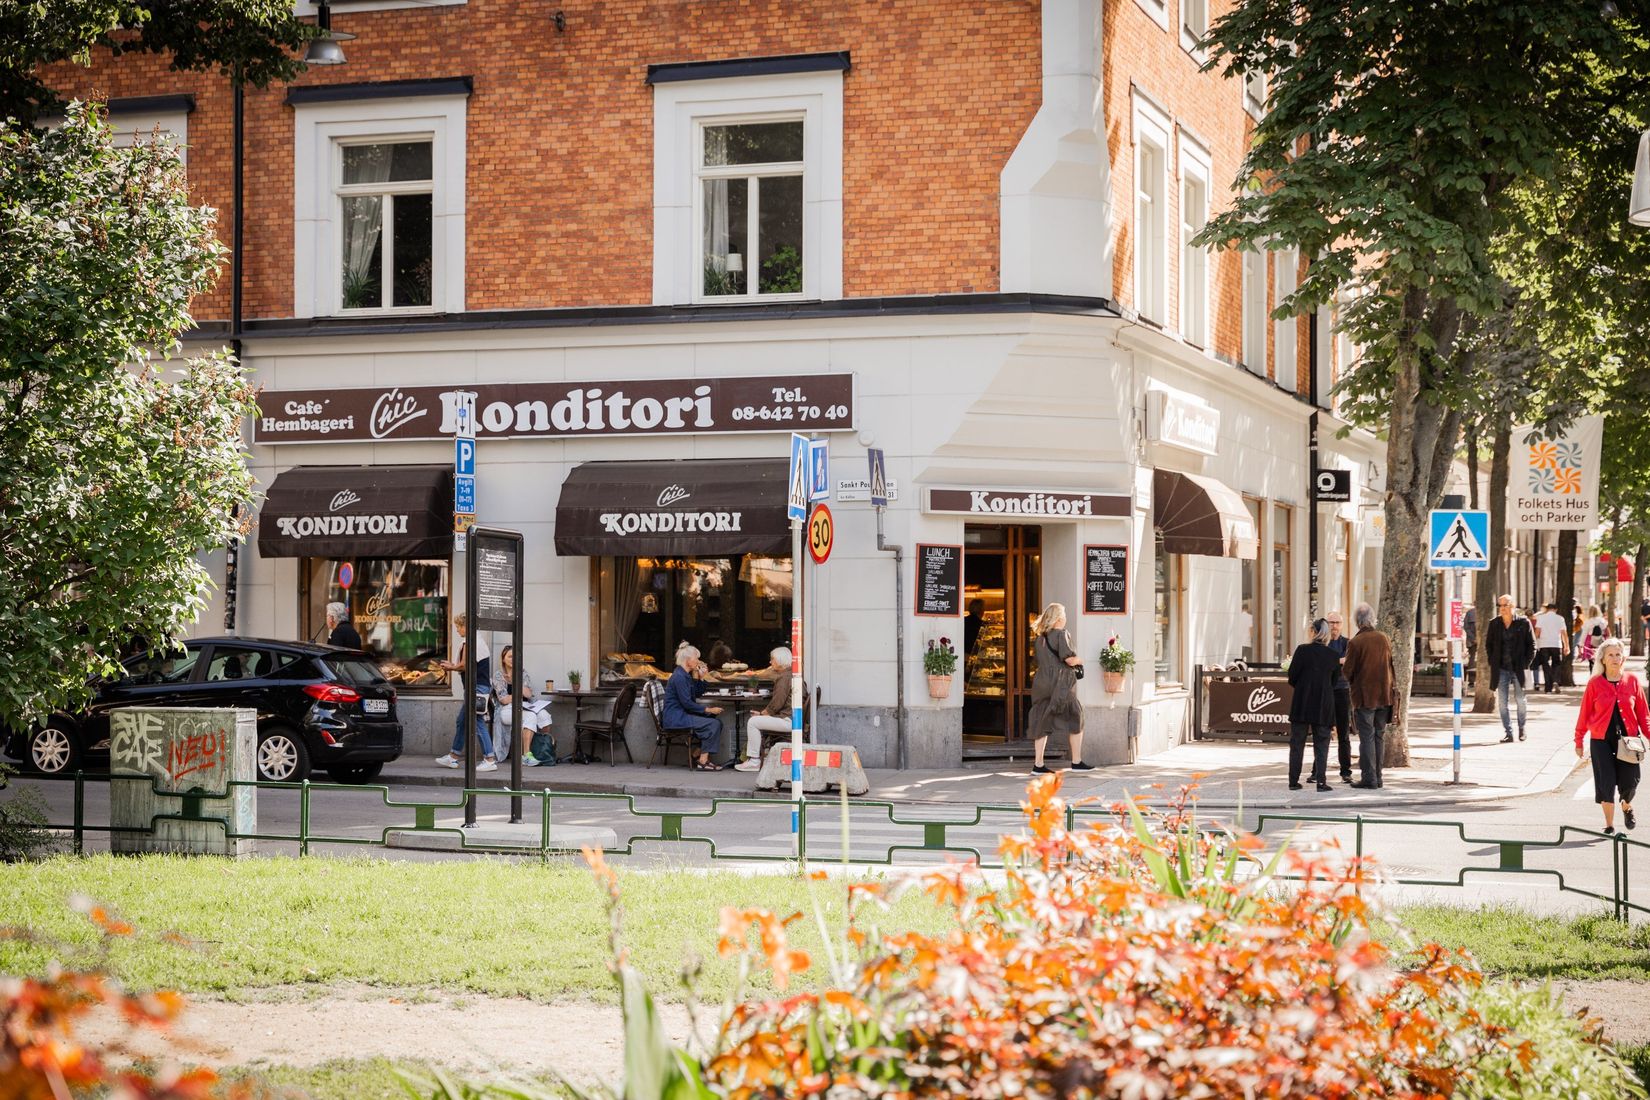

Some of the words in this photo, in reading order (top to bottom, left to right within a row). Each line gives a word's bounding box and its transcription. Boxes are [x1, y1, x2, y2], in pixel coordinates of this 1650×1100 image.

[772, 387, 807, 402] Tel.
[369, 388, 428, 439] Chic
[731, 405, 793, 421] 08-642
[798, 405, 821, 421] 70
[825, 404, 849, 420] 40
[261, 415, 355, 433] Hembageri
[460, 442, 473, 472] P
[840, 480, 858, 489] Sankt
[329, 488, 361, 511] Chic
[656, 483, 691, 507] Chic
[970, 491, 1093, 515] Konditori
[1518, 497, 1562, 509] Folkets
[1566, 497, 1590, 509] Hus
[276, 514, 408, 539] KONDITORI
[600, 512, 742, 535] KONDITORI
[1521, 512, 1543, 523] och
[1547, 512, 1586, 523] Parker
[813, 518, 830, 549] 30
[926, 547, 950, 558] LUNCH
[1087, 581, 1104, 591] KAFFE
[1105, 581, 1114, 591] TO
[1247, 686, 1281, 713] Chic
[1230, 712, 1290, 724] KONDITOR
